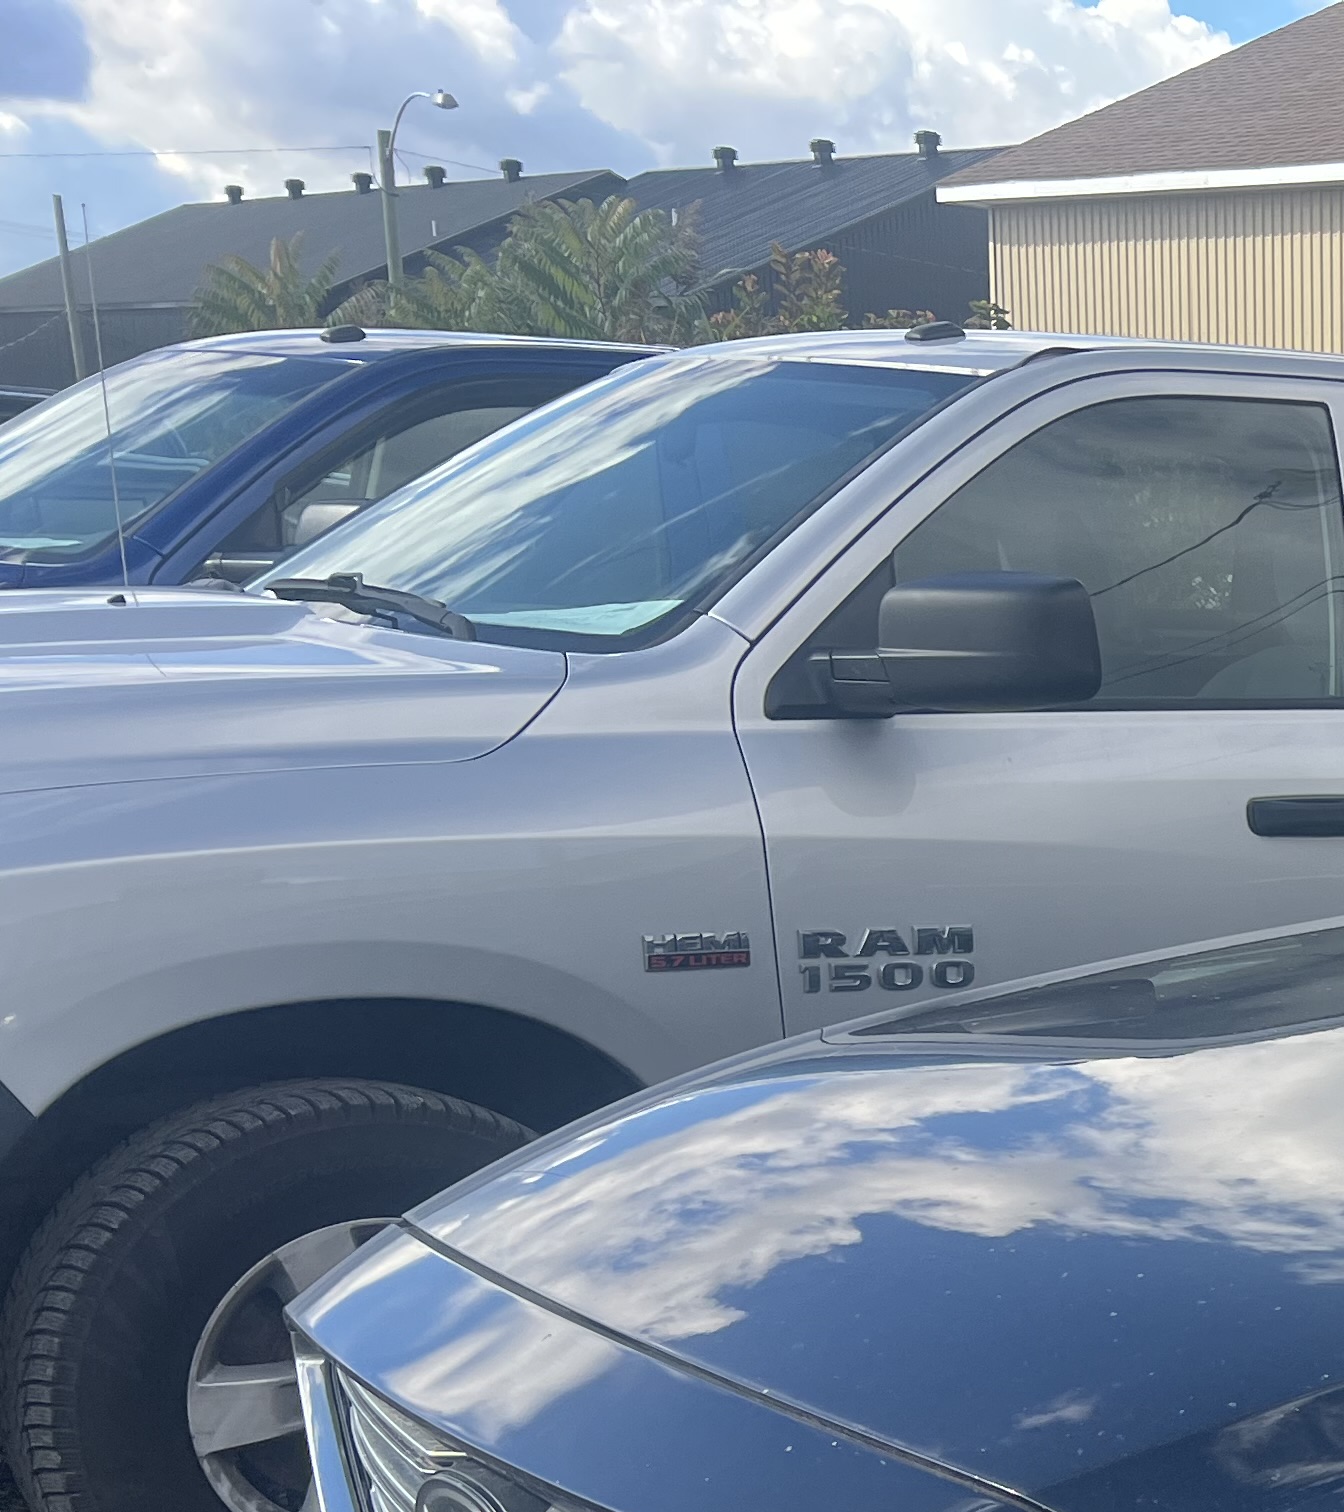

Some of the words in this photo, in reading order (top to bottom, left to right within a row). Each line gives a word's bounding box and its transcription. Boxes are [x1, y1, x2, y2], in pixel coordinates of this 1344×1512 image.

[642, 932, 749, 954] HEMI
[797, 924, 974, 958] RAM
[689, 952, 747, 966] LITER
[800, 960, 975, 993] 1500
